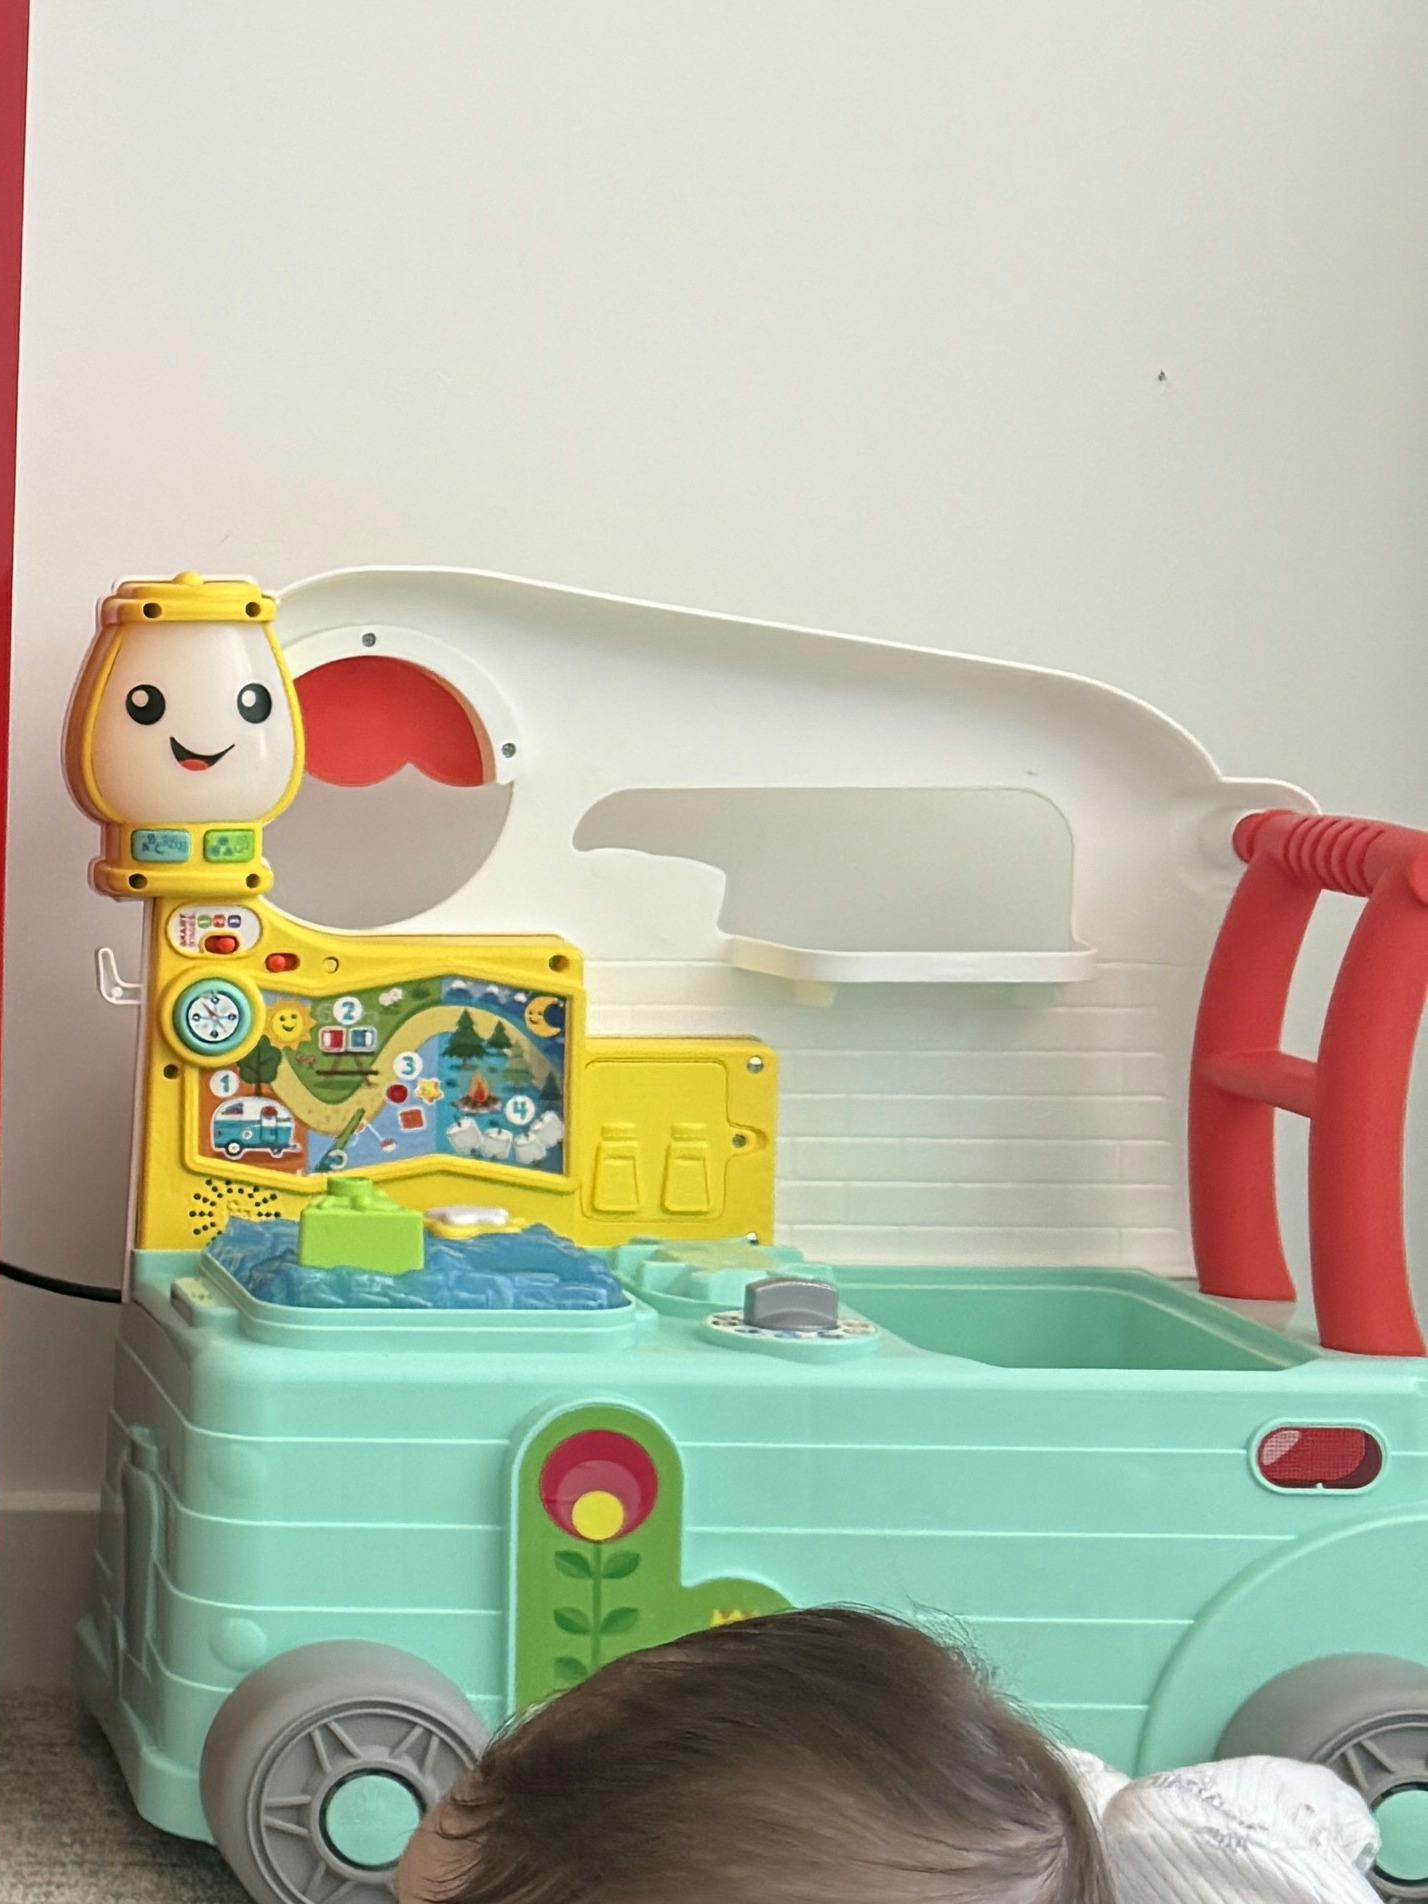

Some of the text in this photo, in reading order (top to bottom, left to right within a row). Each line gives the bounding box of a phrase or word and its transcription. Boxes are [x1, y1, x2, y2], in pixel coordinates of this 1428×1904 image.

[341, 1001, 356, 1021] 2
[401, 1056, 415, 1075] 3
[220, 1074, 230, 1092] 1
[512, 1100, 527, 1119] 4
